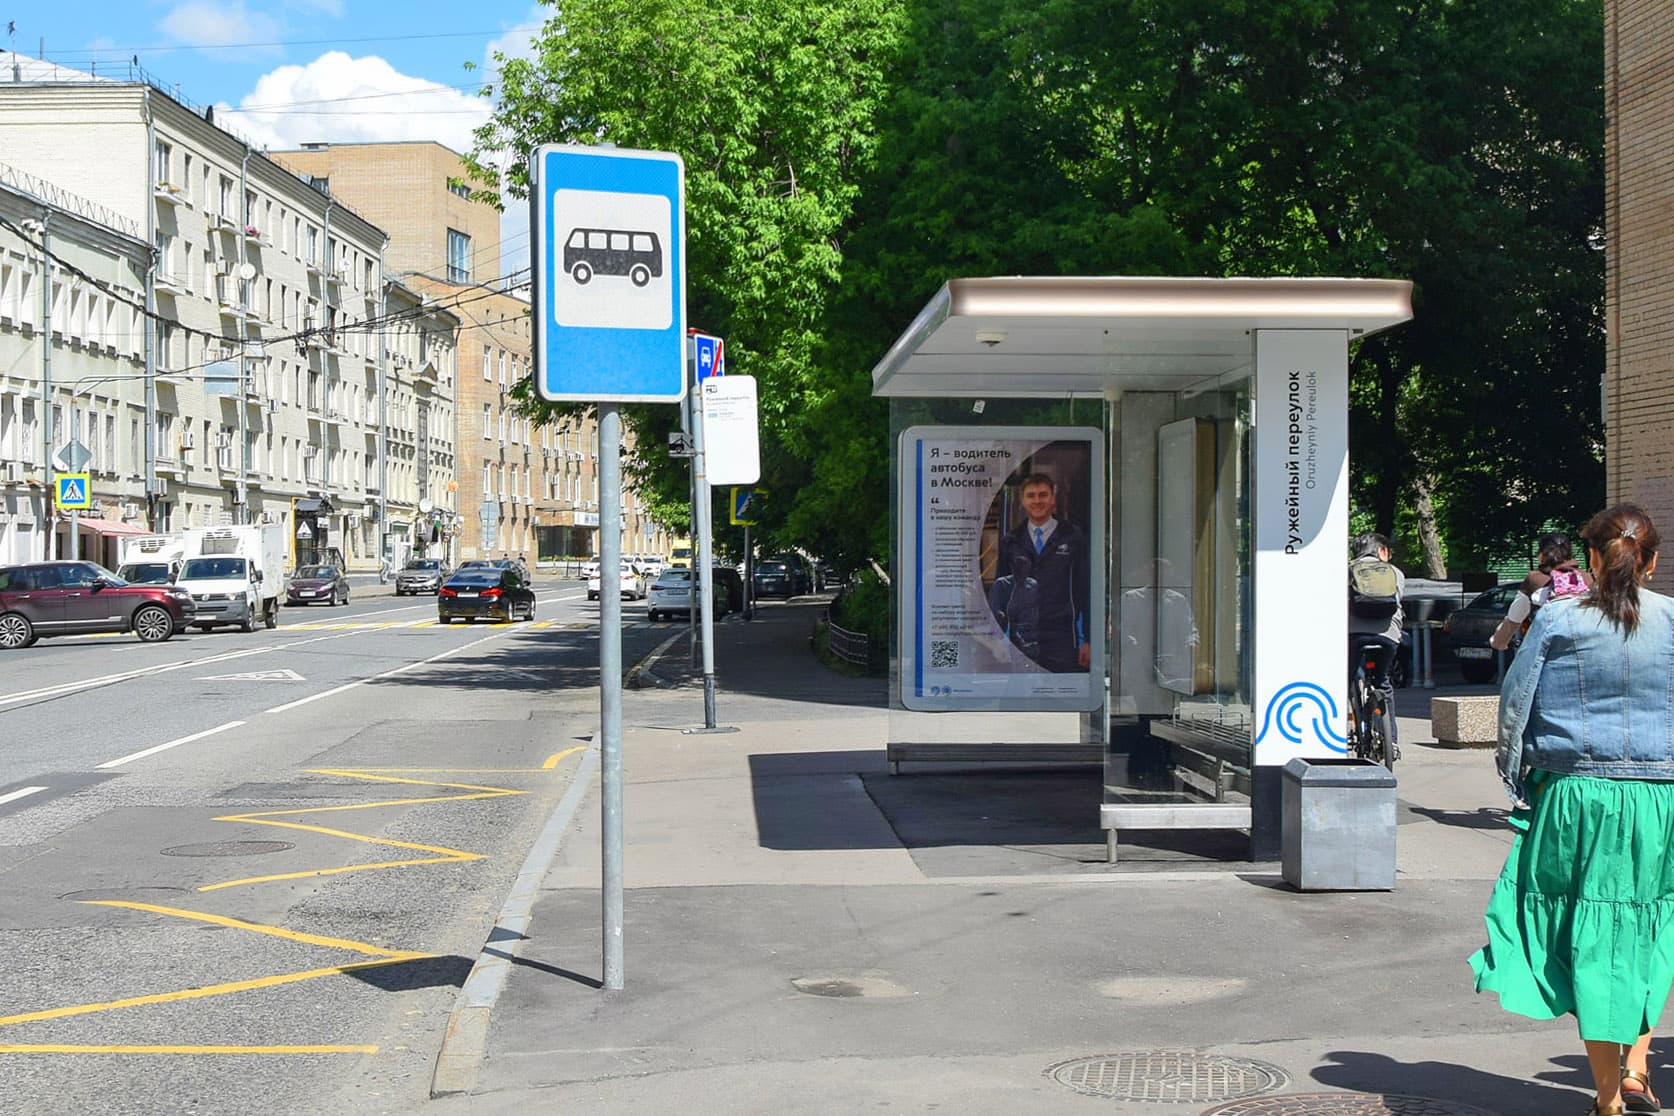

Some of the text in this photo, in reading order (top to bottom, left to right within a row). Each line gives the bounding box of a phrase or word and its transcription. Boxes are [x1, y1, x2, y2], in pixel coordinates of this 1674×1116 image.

[1306, 370, 1318, 490] Oruzheyniy Pereulok
[930, 447, 940, 458] Я
[953, 449, 1012, 459] водитель
[930, 462, 986, 475] автобуса
[1285, 371, 1303, 555] Ружейный переулок
[931, 476, 993, 488] в Москве!
